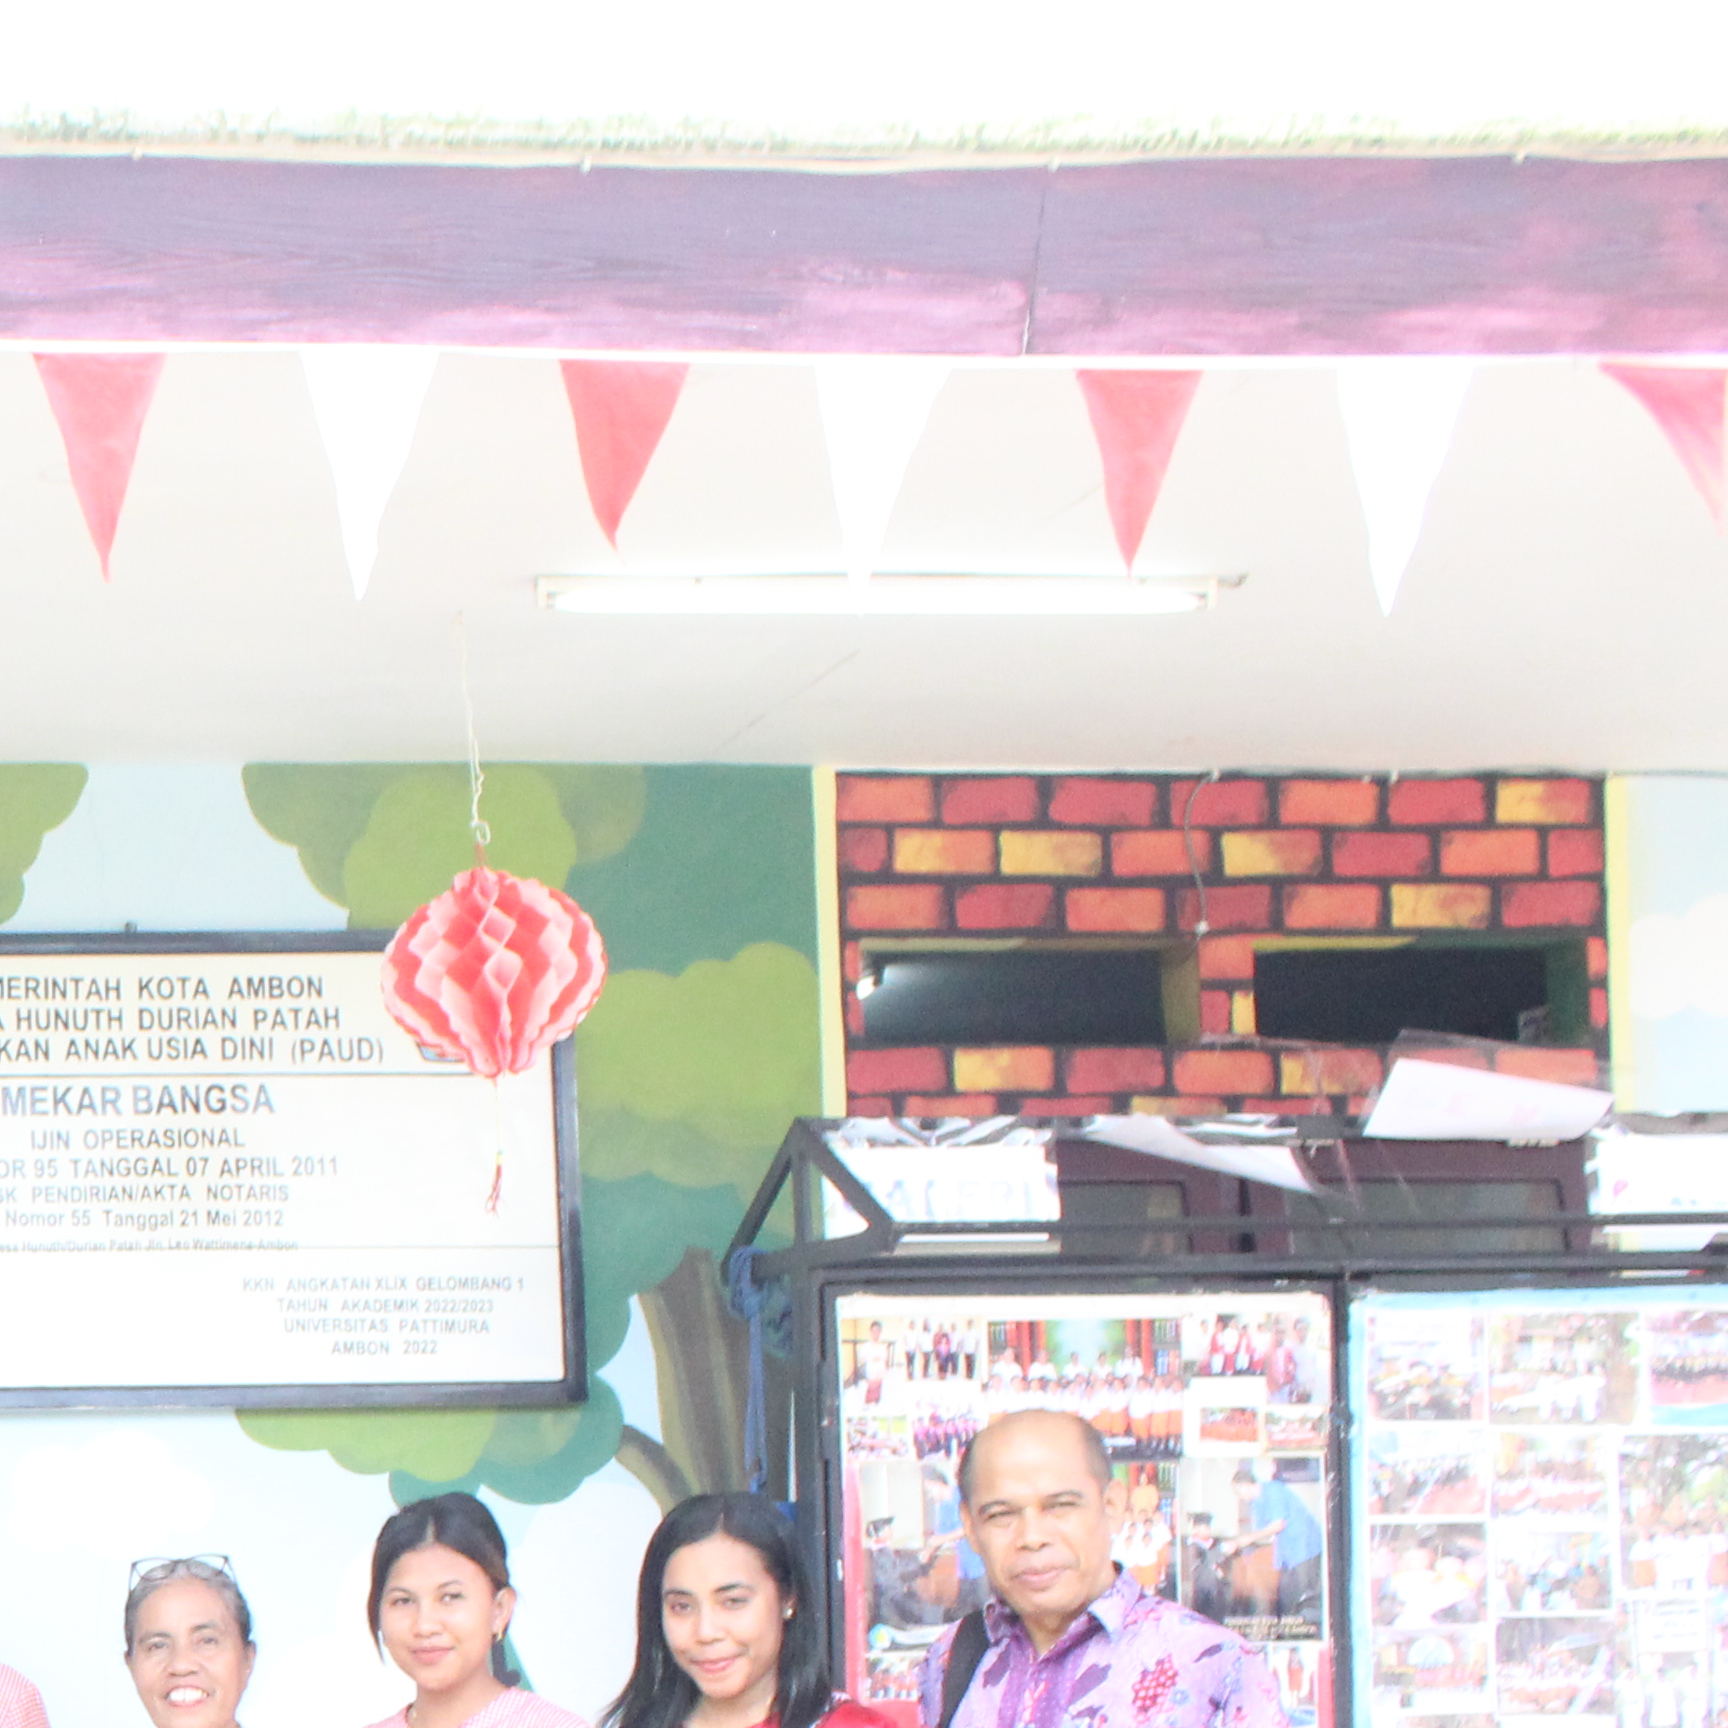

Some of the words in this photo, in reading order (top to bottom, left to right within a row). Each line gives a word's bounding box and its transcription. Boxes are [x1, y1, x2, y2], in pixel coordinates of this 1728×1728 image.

[138, 976, 209, 1001] KOTA
[227, 976, 323, 1000] AMBON
[16, 1008, 123, 1032] HUNUTH
[138, 1007, 237, 1032] DURIAN
[253, 1007, 339, 1031] PATAH
[65, 1038, 137, 1061] ANAK
[147, 1036, 208, 1061] USIA
[221, 1036, 273, 1062] DINI
[291, 1037, 383, 1064] (PAUD)
[2, 1085, 122, 1116] MEKAR
[133, 1083, 274, 1115] BANGSA
[31, 1129, 71, 1151] IJIN
[84, 1128, 245, 1150] OPERASIONAL
[34, 1157, 58, 1179] 95
[70, 1156, 179, 1178] TANGGAL
[185, 1156, 209, 1178] 07
[219, 1157, 284, 1179] APRIL
[291, 1155, 337, 1177] 2011
[32, 1183, 191, 1203] PENDIRIAN/AKTA
[206, 1183, 289, 1203] NOTARIS
[5, 1209, 66, 1227] Nomor
[71, 1208, 91, 1227] 55
[102, 1209, 175, 1232] Tanggal
[179, 1209, 198, 1228] 21
[206, 1209, 236, 1227] Mei
[242, 1209, 284, 1227] 2012
[243, 1277, 275, 1291] KKN
[287, 1276, 372, 1292] ANGKATAN
[416, 1275, 512, 1291] GELOMBANG
[276, 1298, 329, 1312] TAHUN
[341, 1298, 419, 1313] AKADEMIK
[425, 1298, 494, 1313] 2022/2023
[284, 1317, 390, 1333] UNIVERSITAS
[399, 1318, 490, 1334] PATTIMURA
[331, 1340, 390, 1355] AMBON
[403, 1339, 438, 1355] 2022
